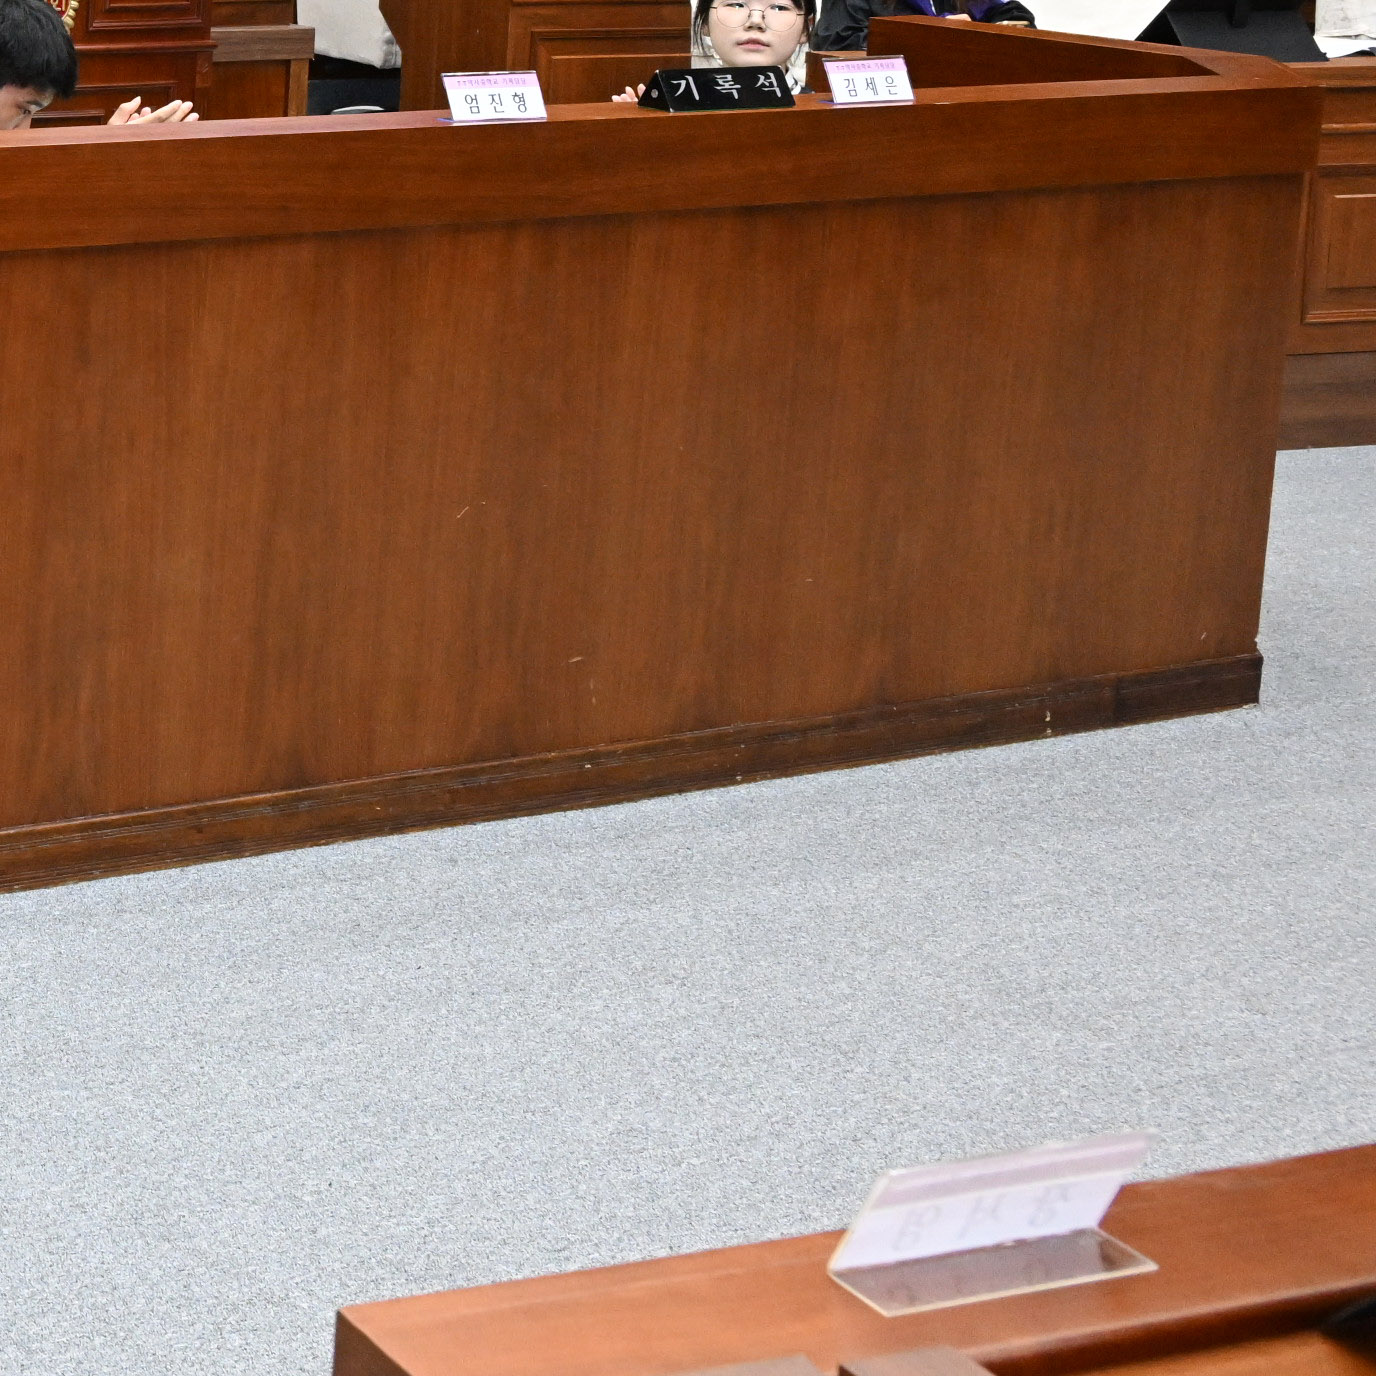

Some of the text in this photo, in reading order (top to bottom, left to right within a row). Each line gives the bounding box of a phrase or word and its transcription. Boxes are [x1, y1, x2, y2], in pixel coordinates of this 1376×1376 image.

[670, 71, 783, 101] 기록석
[843, 75, 899, 97] 김세은
[464, 91, 528, 114] 엄진형
